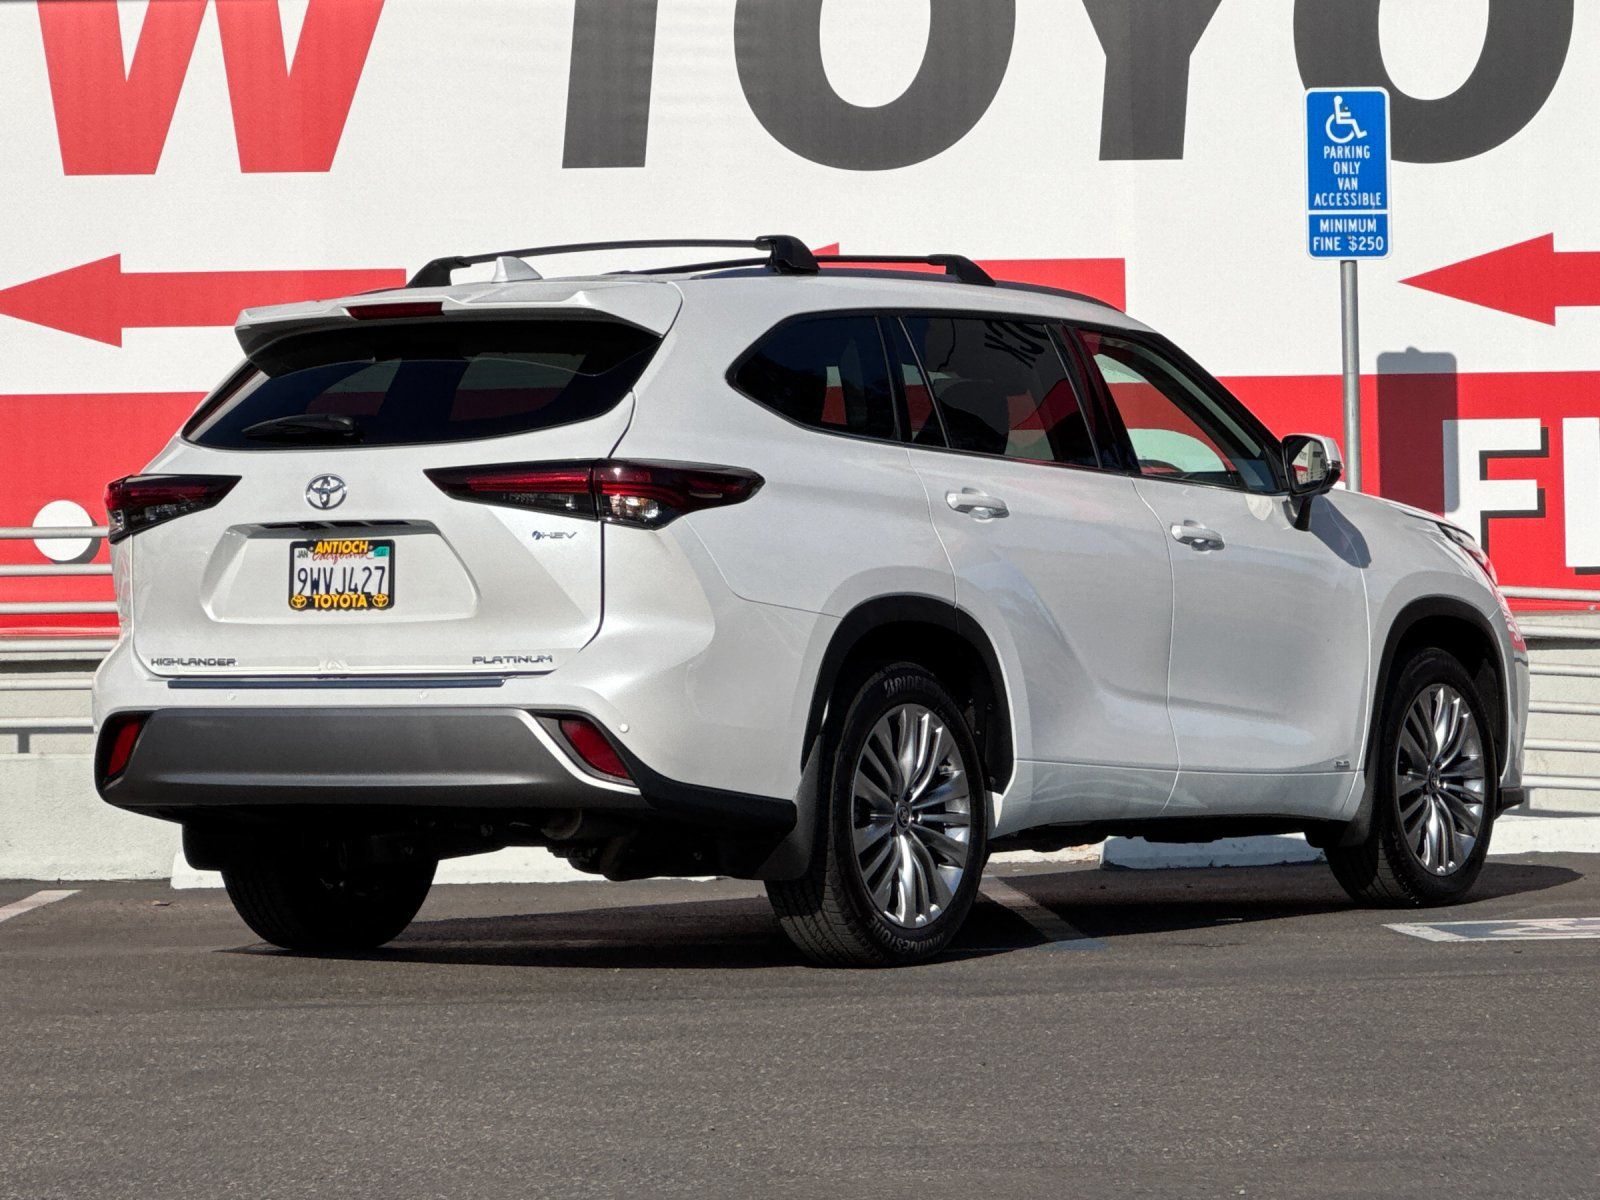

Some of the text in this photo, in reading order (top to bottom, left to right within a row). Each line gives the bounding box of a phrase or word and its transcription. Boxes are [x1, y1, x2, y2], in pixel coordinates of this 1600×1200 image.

[1323, 145, 1371, 159] PARKING
[1333, 161, 1361, 175] ONLY
[1337, 177, 1358, 191] VAN
[1313, 192, 1382, 207] ACCESSIBLE
[1319, 218, 1377, 233] MINIMUM
[1313, 235, 1384, 252] FINE $250
[296, 549, 309, 559] JAN
[314, 540, 369, 554] ANTIOCH
[297, 565, 386, 596] 9WVJ427
[313, 593, 368, 609] TOYOTA
[150, 657, 237, 667] HIGHLANDER
[472, 654, 553, 665] PLATINUM
